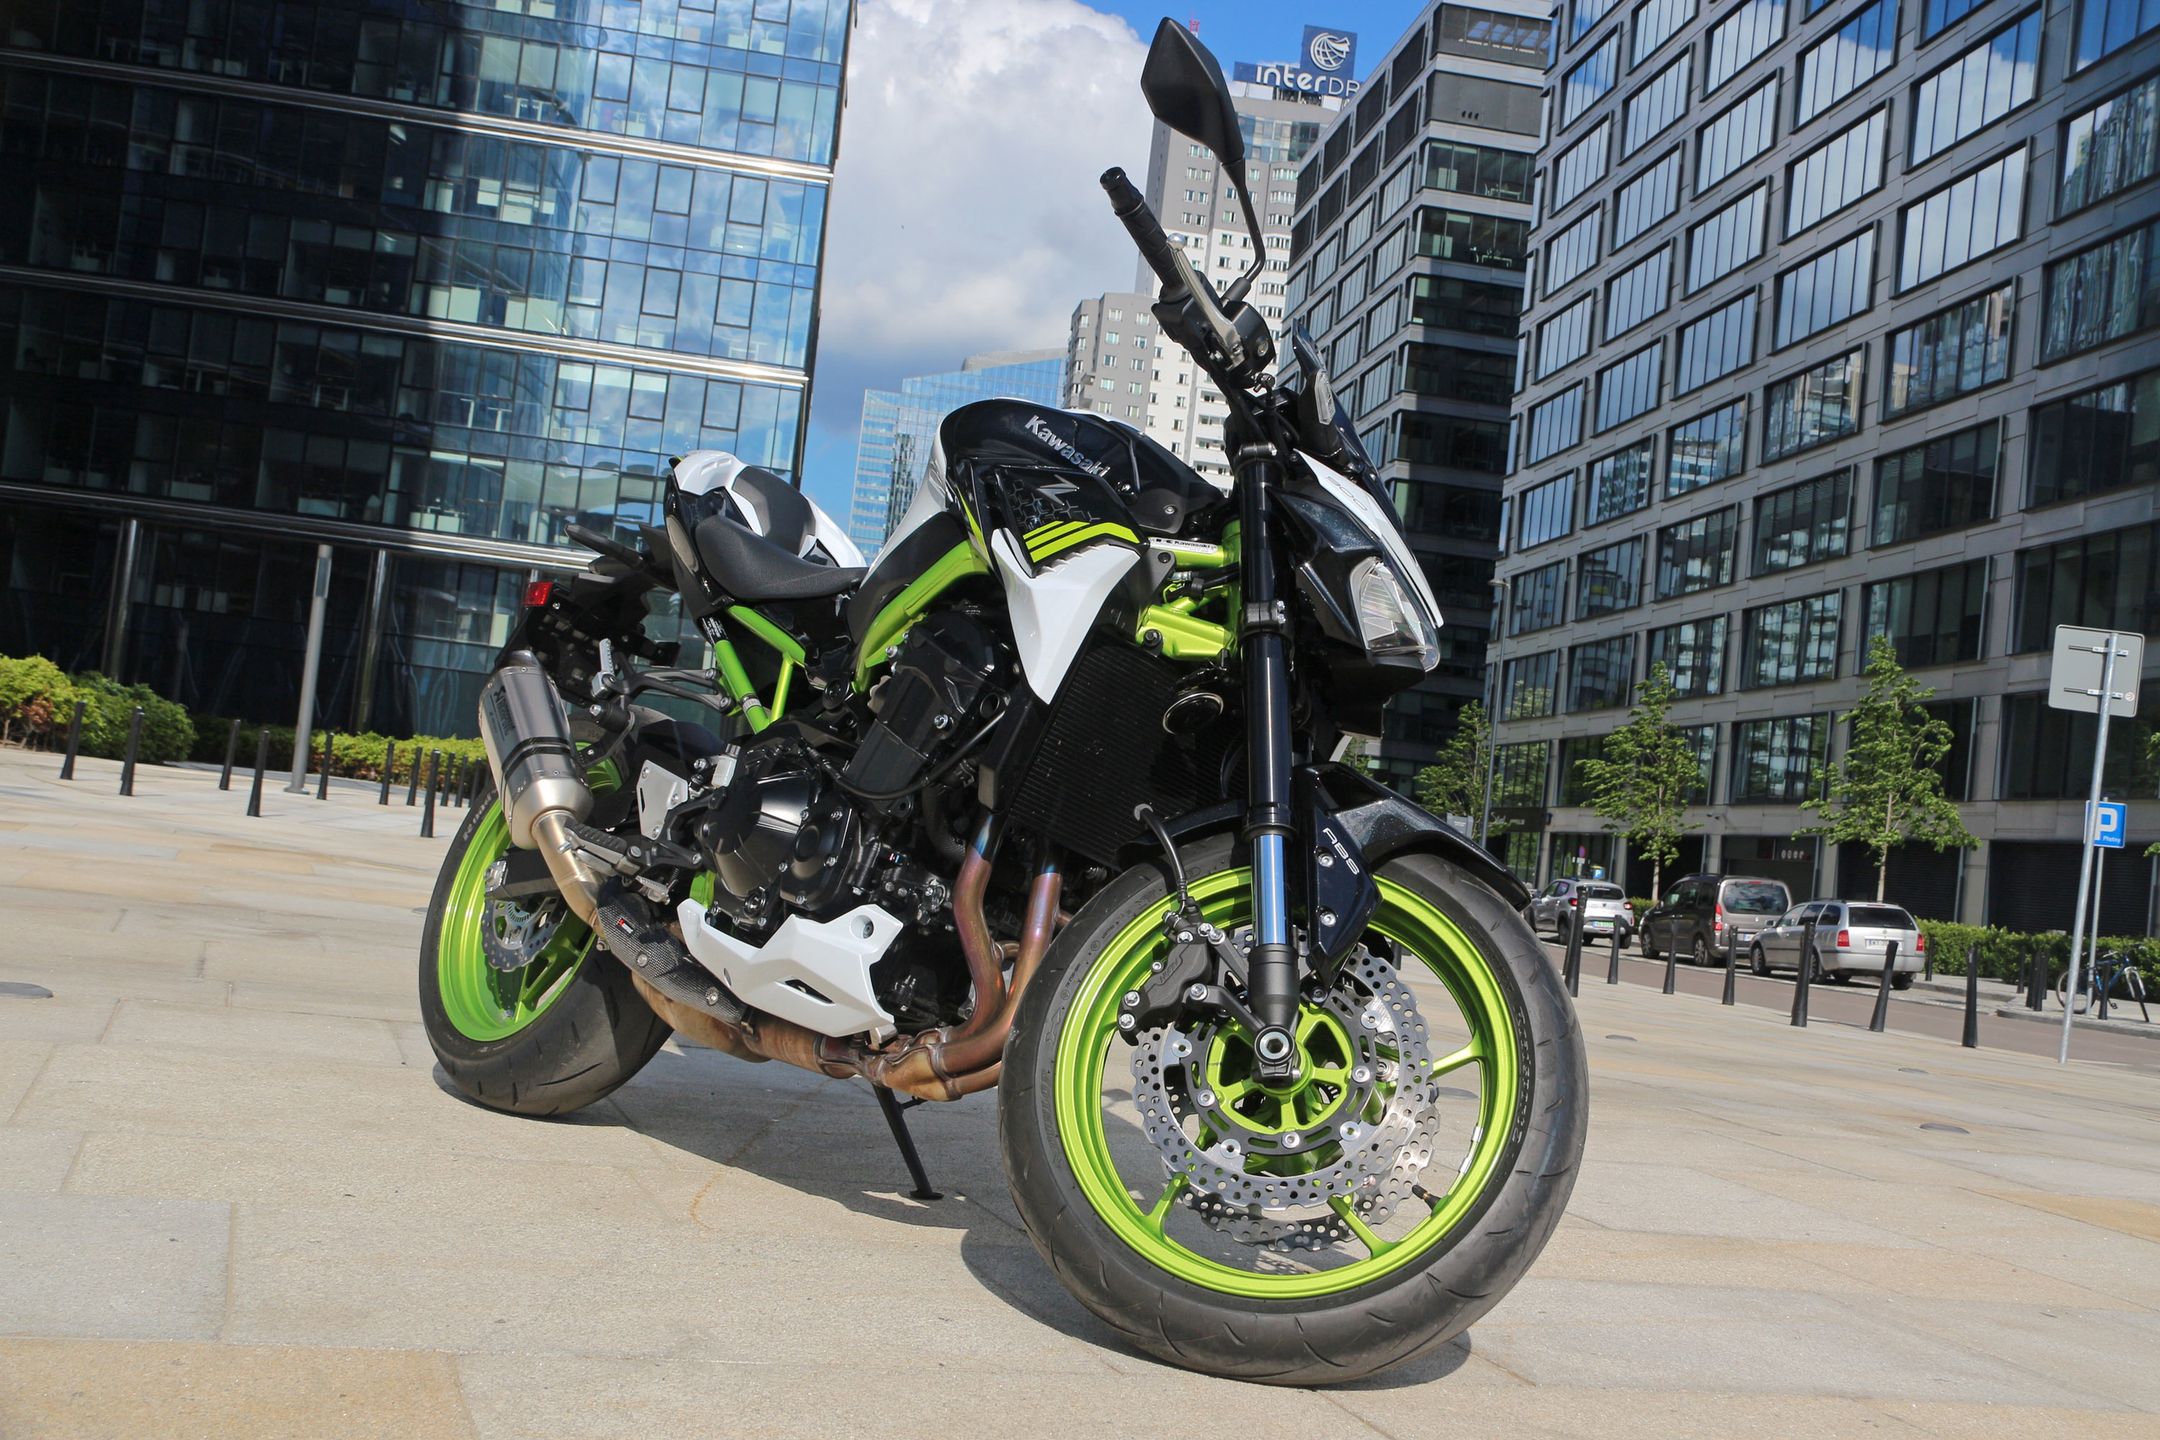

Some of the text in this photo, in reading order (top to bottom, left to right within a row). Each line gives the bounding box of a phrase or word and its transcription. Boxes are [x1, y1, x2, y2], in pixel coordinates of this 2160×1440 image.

[1025, 414, 1111, 478] Kawasaki
[2094, 807, 2118, 841] P
[1322, 827, 1360, 875] ABS
